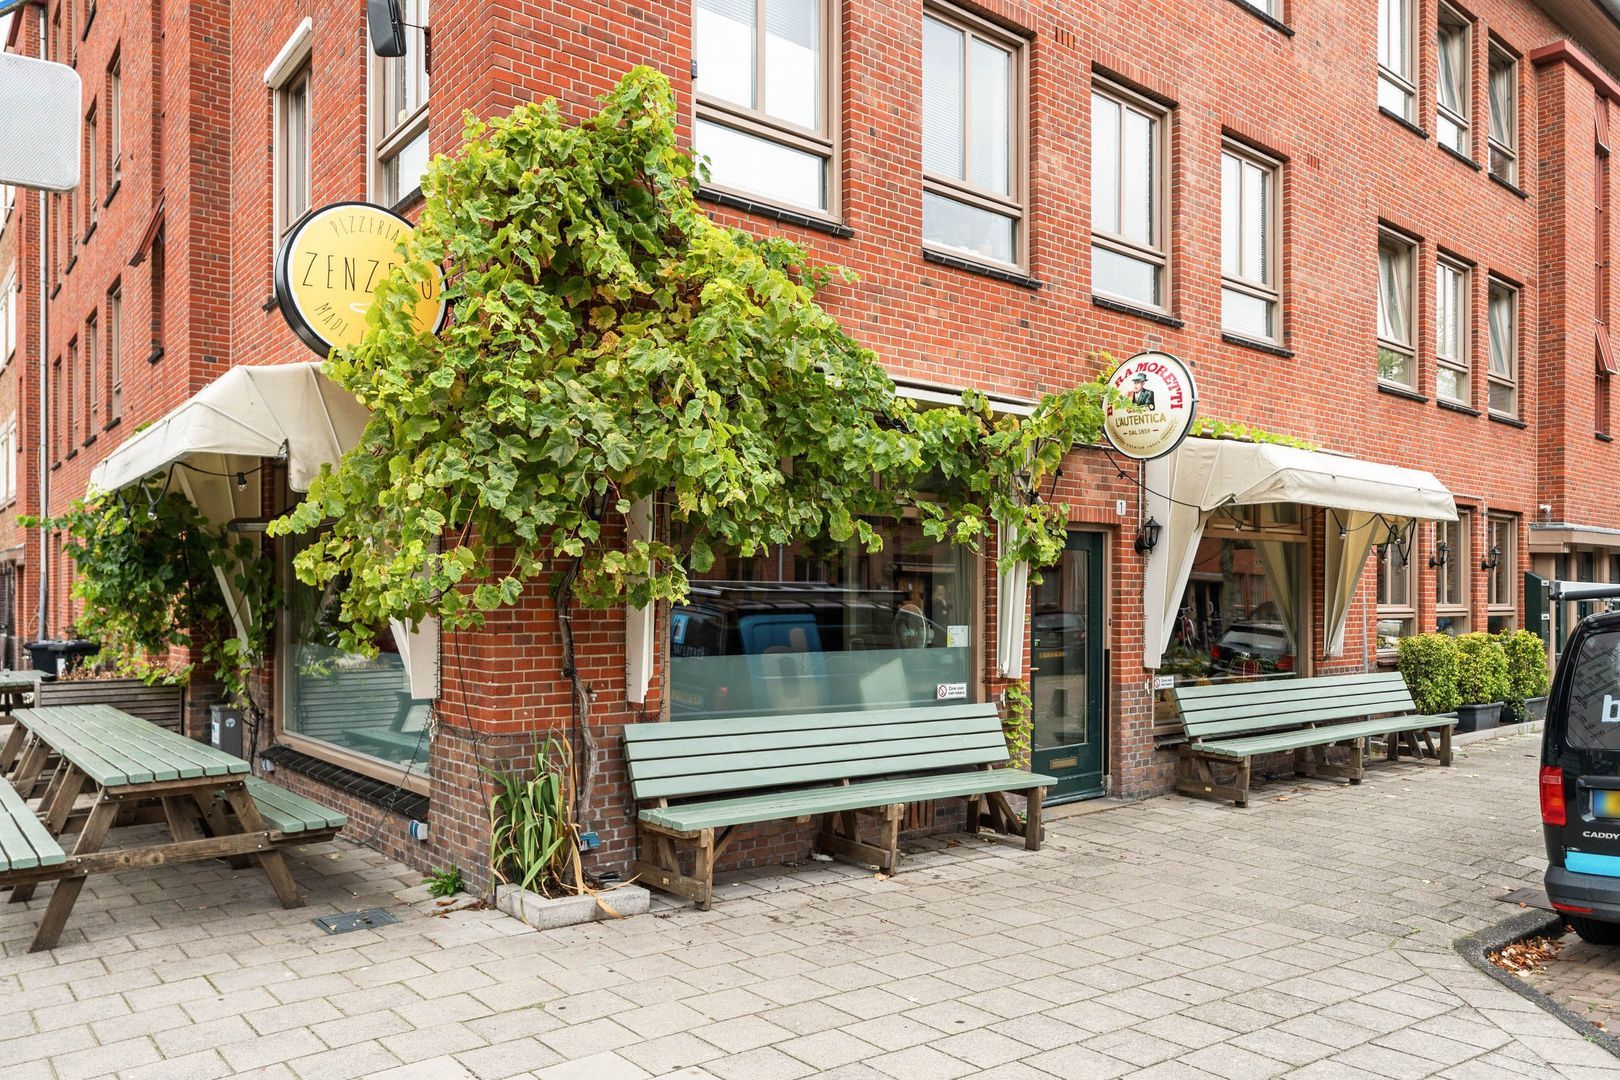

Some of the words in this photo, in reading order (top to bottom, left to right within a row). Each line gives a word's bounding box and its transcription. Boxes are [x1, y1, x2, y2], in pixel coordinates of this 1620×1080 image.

[329, 215, 400, 243] PIZZERIA
[314, 302, 350, 337] MADE
[1135, 361, 1184, 410] MORETTI
[1582, 830, 1620, 840] CADDY
